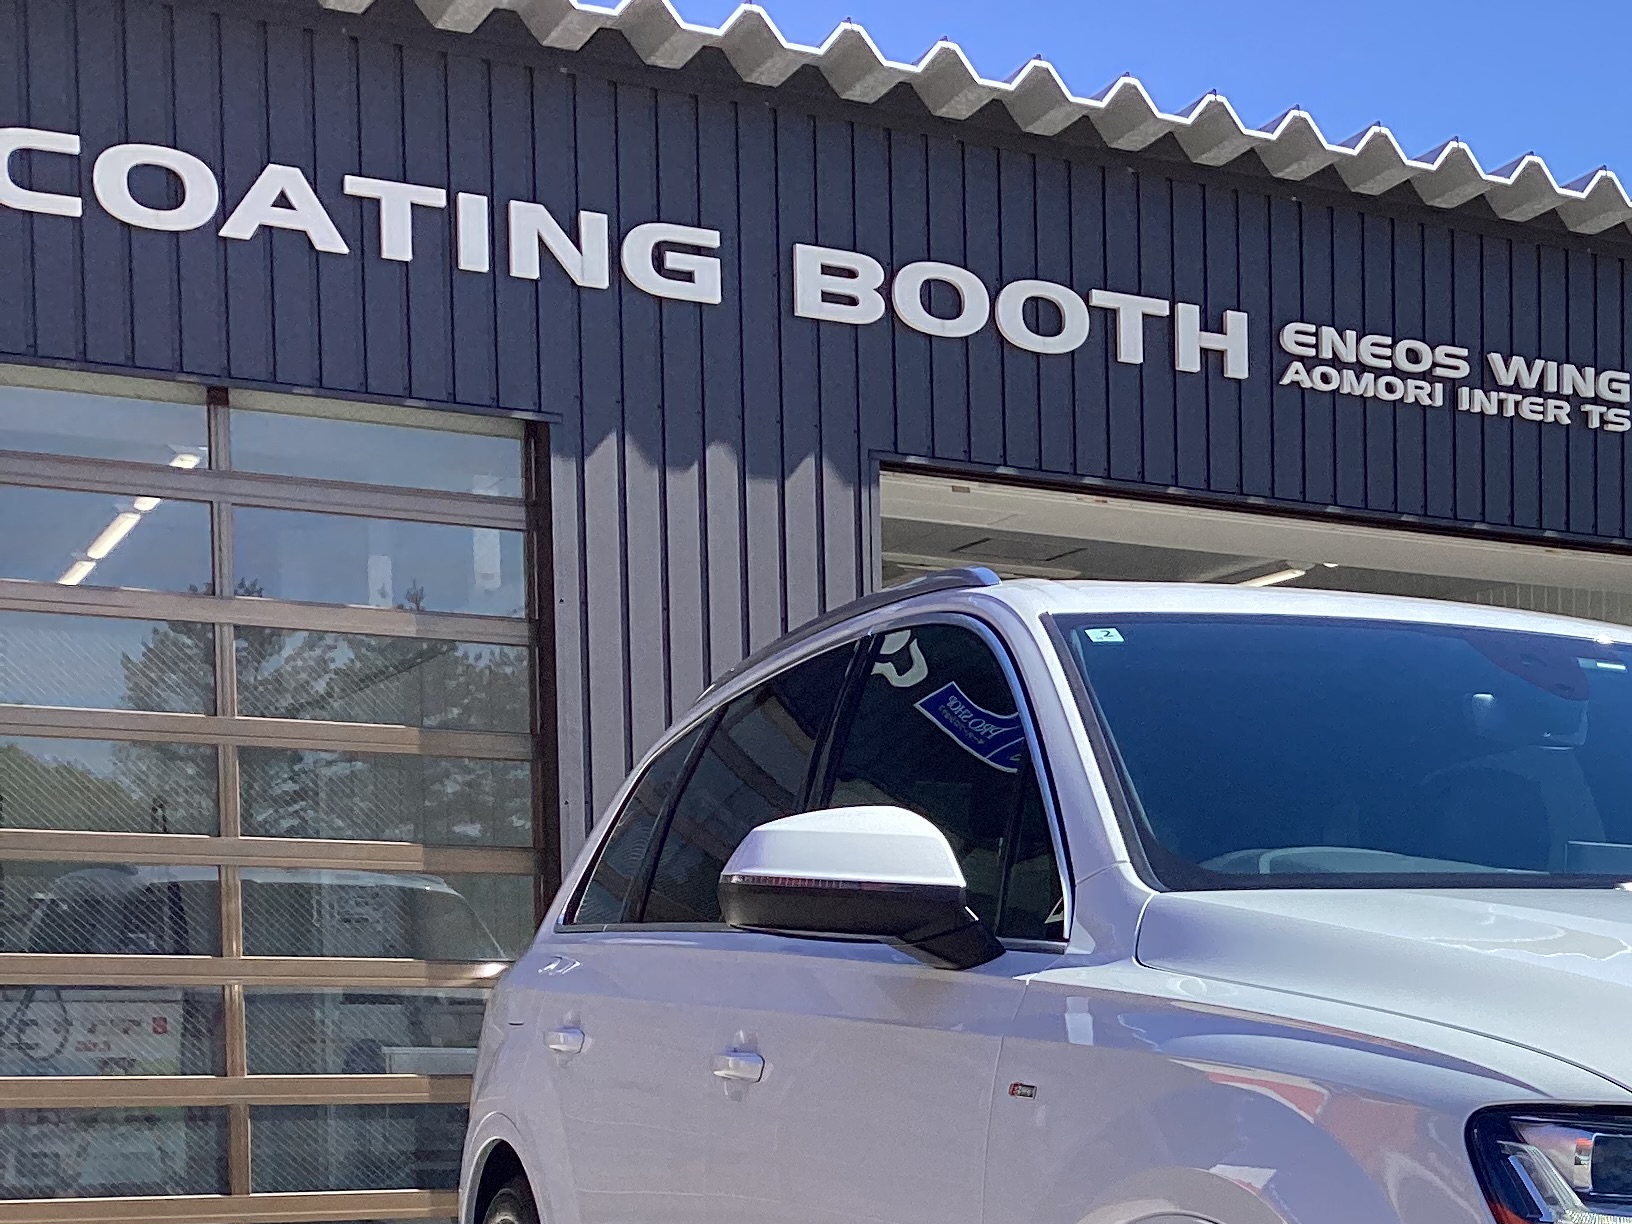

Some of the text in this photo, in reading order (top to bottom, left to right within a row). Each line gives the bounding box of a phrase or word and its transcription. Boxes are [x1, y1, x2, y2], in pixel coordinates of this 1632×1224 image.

[0, 126, 1250, 380] COATING BOOTH
[1279, 360, 1632, 433] AOMORI INTER TS
[1280, 322, 1631, 404] ENEOS WING
